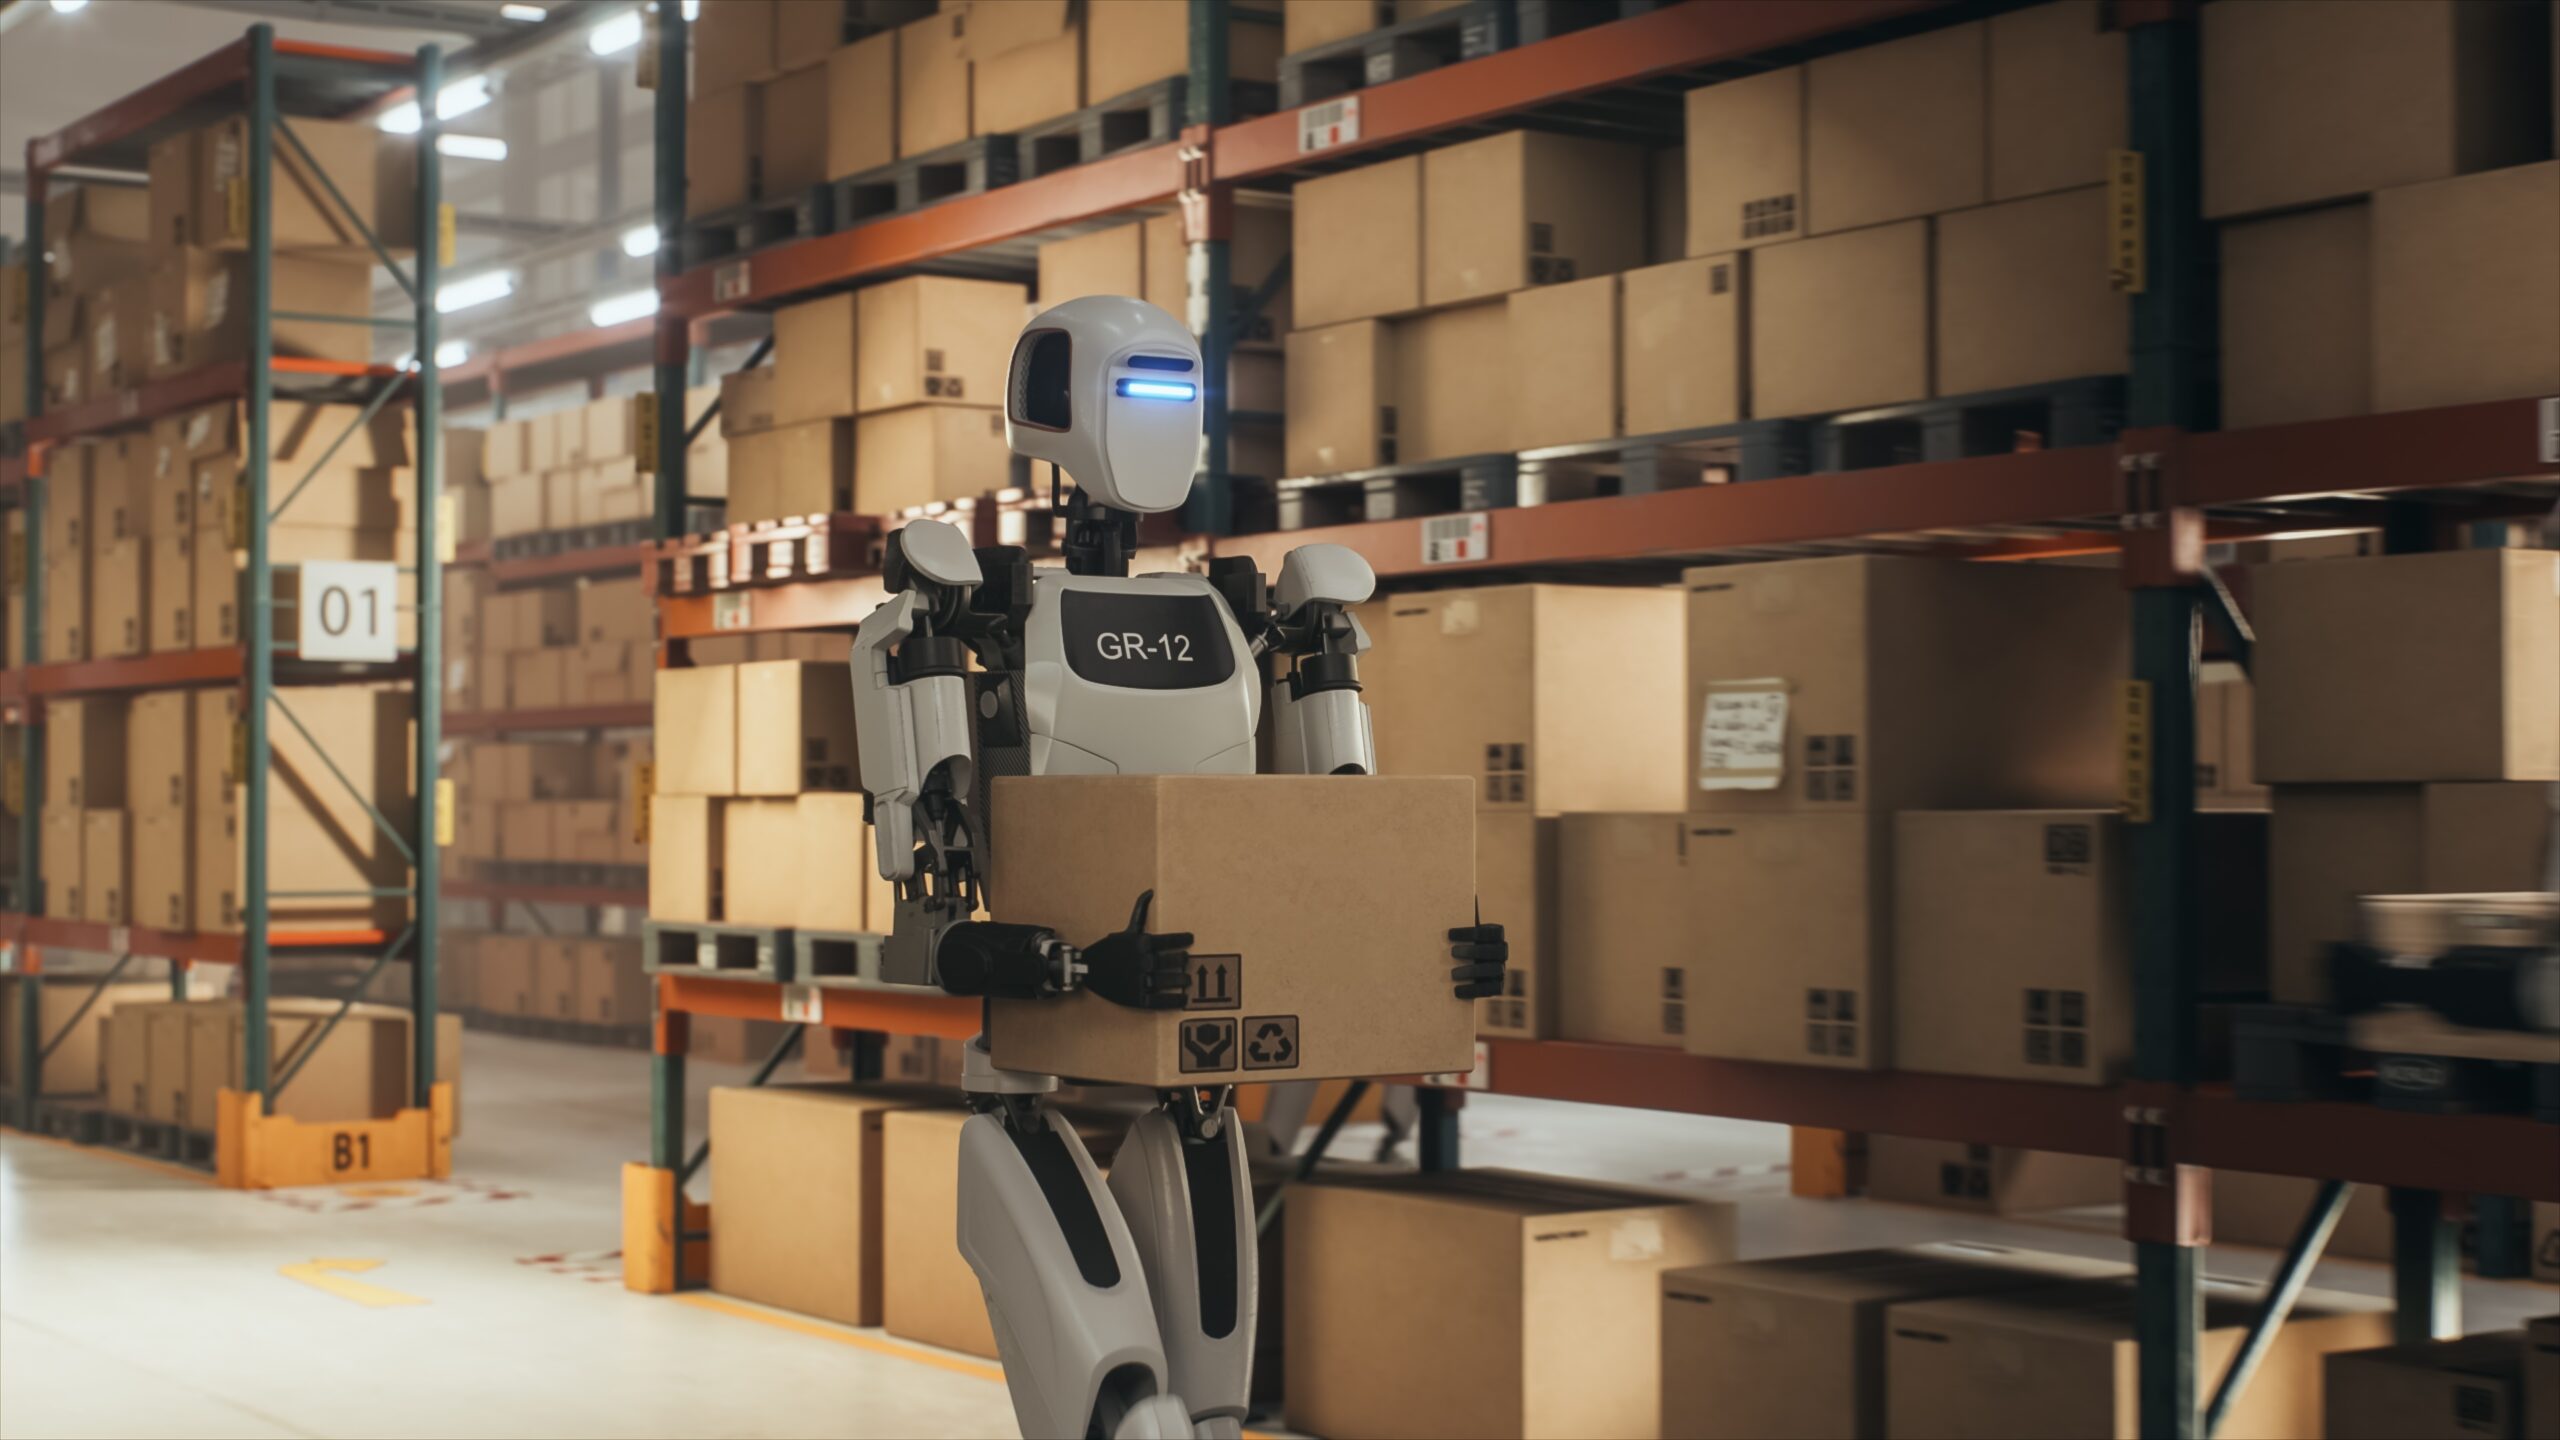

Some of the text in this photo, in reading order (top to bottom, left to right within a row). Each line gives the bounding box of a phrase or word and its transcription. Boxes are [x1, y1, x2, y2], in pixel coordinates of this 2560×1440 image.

[320, 586, 377, 636] 01
[1097, 632, 1194, 661] GR-12
[334, 1132, 370, 1171] B1
